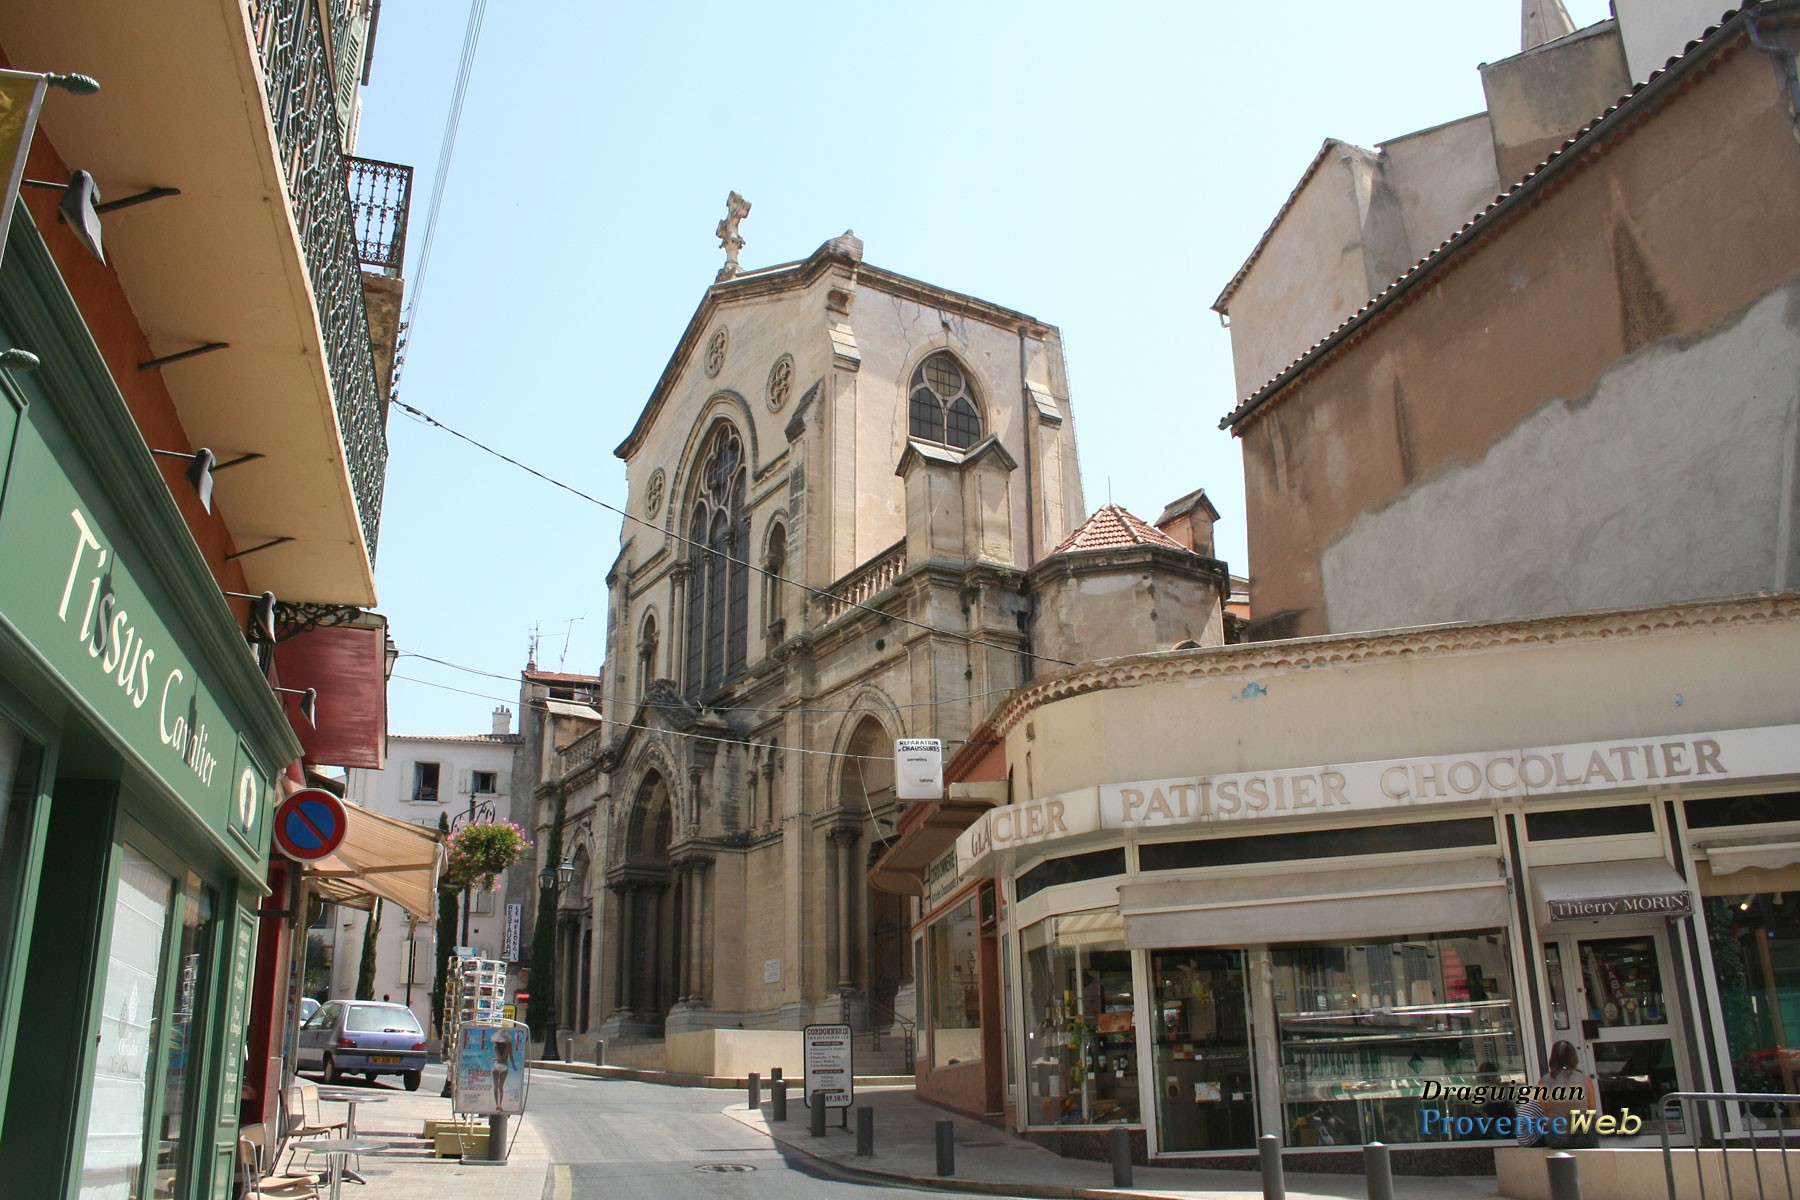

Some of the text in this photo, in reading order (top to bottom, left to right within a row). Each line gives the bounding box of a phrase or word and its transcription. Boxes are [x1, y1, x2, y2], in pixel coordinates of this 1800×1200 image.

[59, 508, 217, 788] Tissus Cavalier
[1379, 739, 1729, 800] CHOCOLATIER
[1120, 771, 1351, 823] PATISSIER
[971, 800, 1068, 858] GLACIER
[505, 905, 513, 956] RESTAURAN
[1555, 896, 1683, 915] Thierry MORIN
[463, 1029, 525, 1052] ELE
[807, 1028, 848, 1036] CORDONNERIE
